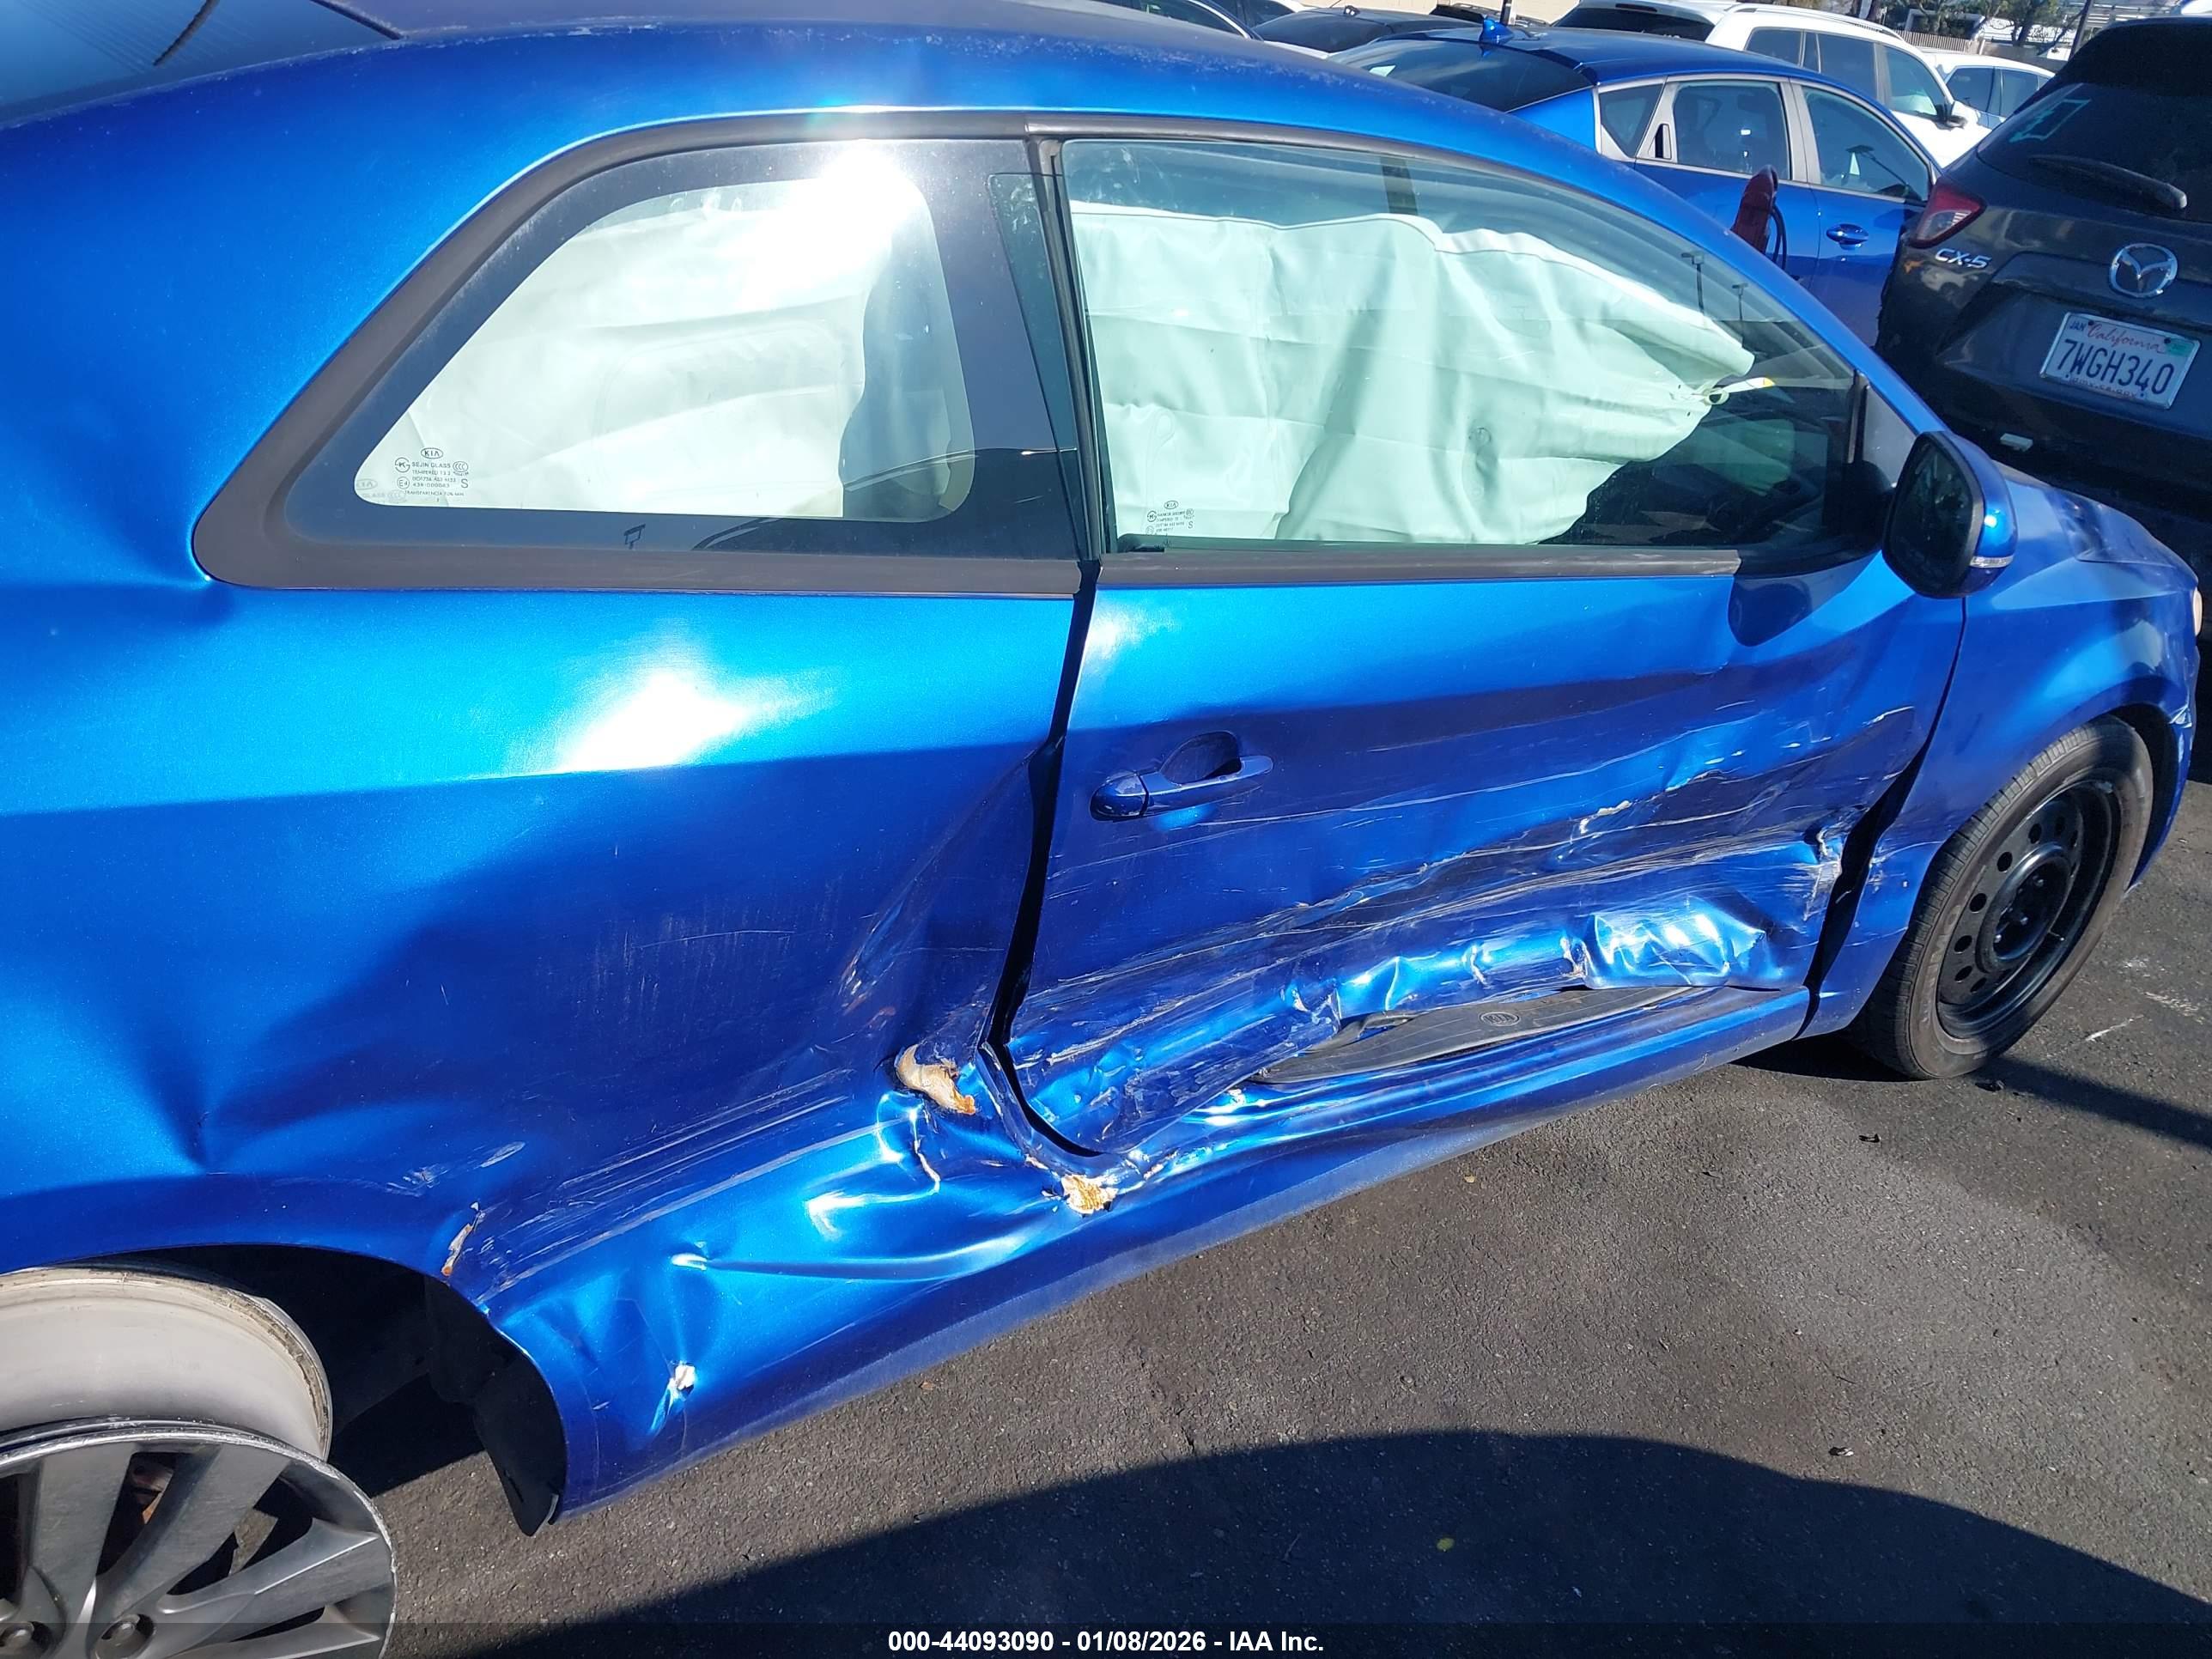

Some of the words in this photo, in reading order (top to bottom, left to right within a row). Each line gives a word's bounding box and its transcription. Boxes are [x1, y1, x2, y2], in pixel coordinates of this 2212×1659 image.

[1935, 248, 1992, 269] CX-5
[2087, 323, 2167, 355] California
[2057, 338, 2175, 395] 7WGH340
